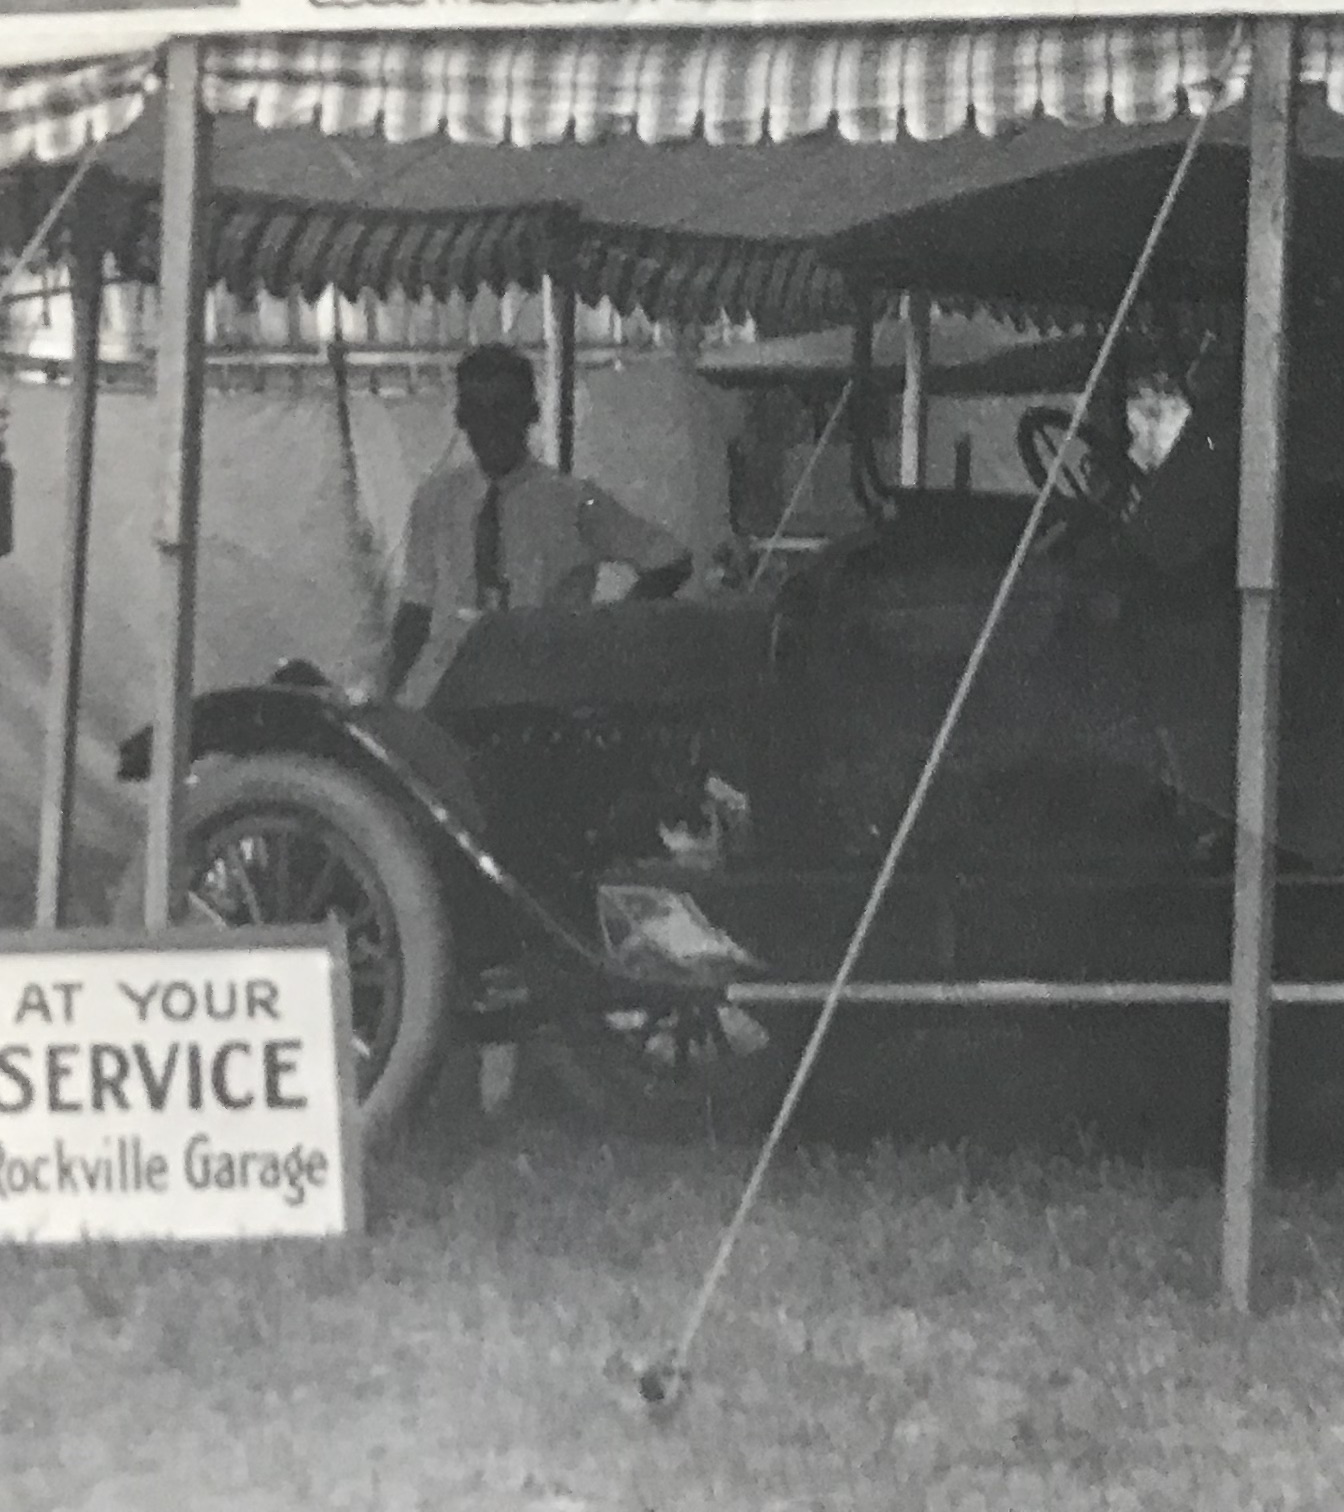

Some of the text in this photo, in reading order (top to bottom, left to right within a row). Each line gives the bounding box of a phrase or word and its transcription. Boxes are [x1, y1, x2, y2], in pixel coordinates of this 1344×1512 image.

[14, 978, 282, 1026] AT YOUR
[183, 1131, 330, 1208] Garage
